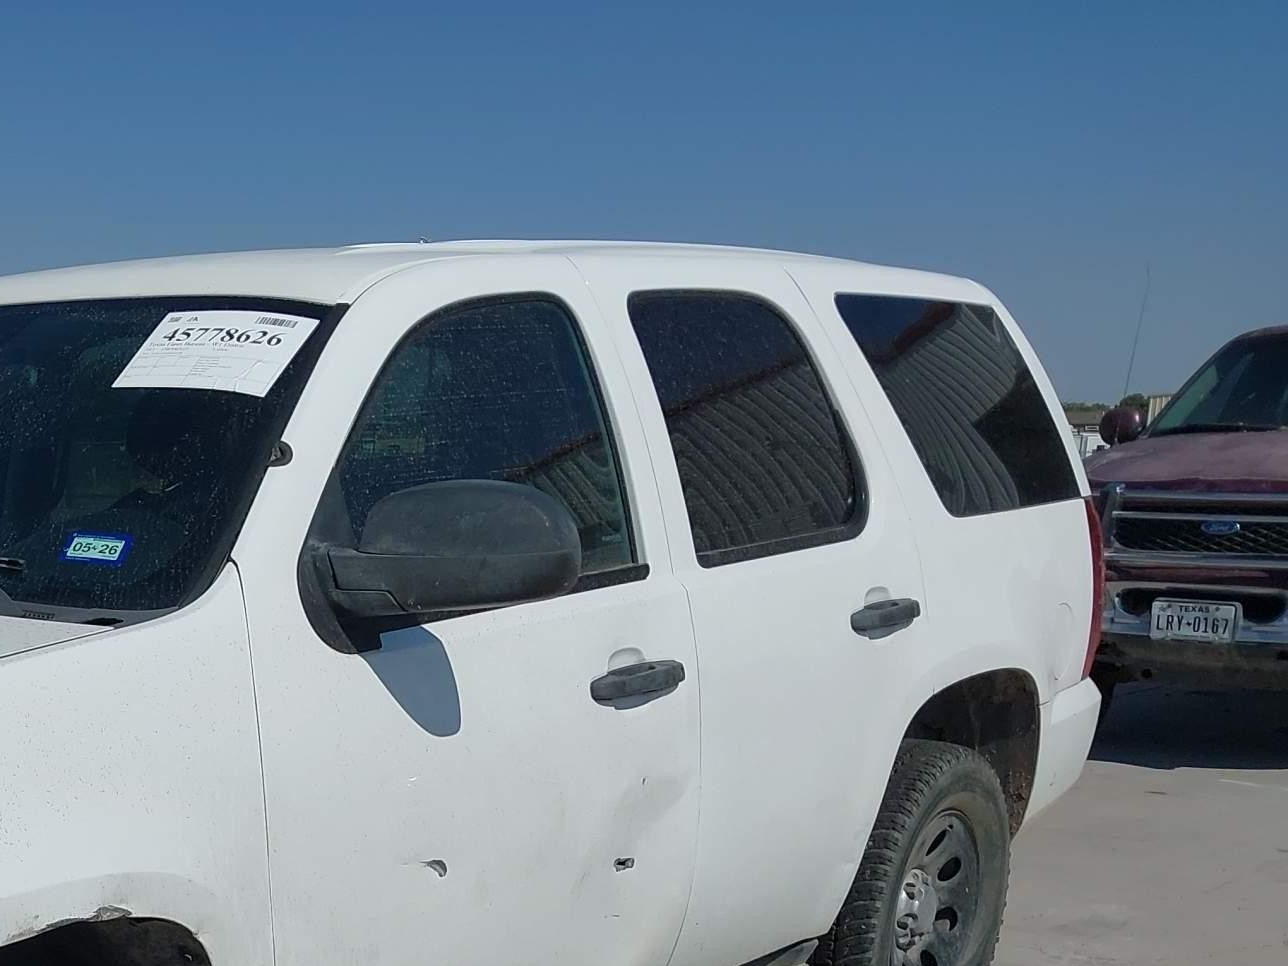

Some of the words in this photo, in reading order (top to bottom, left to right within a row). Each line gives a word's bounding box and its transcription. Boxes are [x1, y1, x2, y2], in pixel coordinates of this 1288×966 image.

[163, 328, 287, 346] 45778626
[98, 544, 119, 555] 26
[1178, 605, 1210, 613] TEXAS
